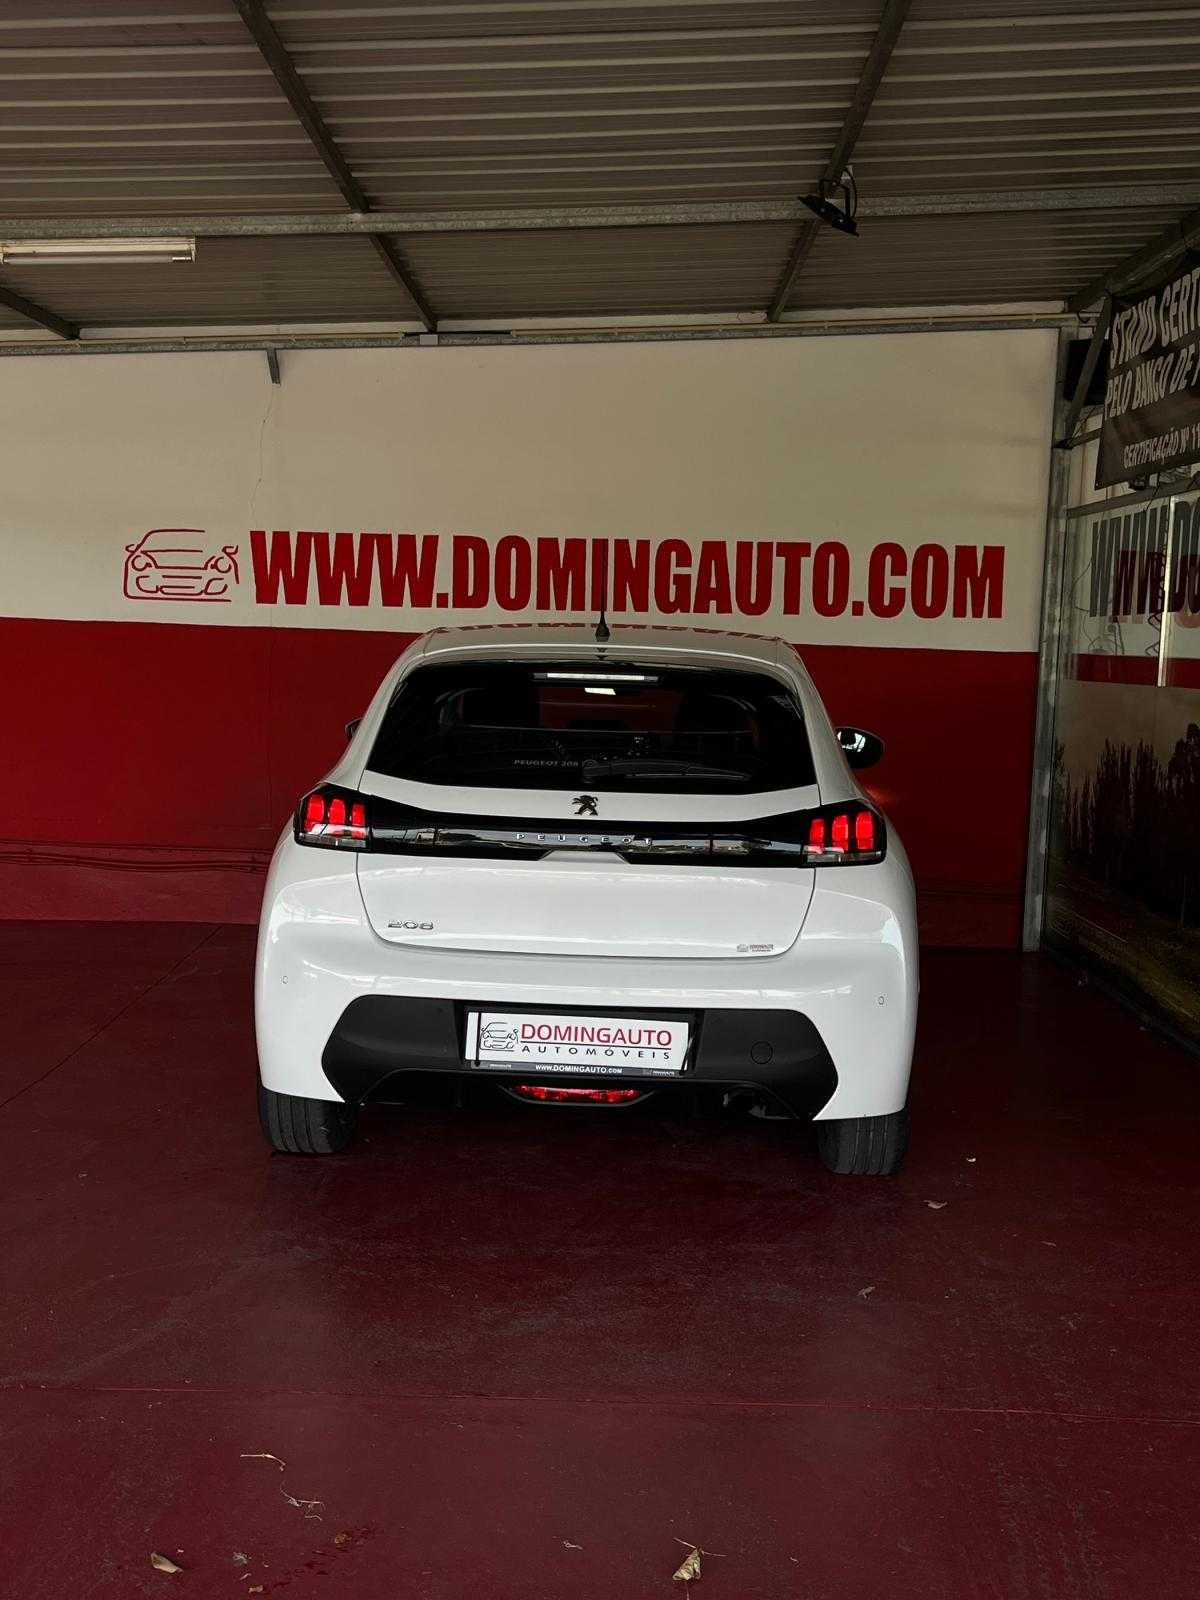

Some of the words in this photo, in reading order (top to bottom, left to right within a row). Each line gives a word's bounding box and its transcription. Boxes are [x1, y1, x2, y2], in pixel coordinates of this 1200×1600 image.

[1110, 295, 1156, 370] STAND
[1104, 369, 1133, 420] PELO
[1131, 353, 1175, 410] BANCO
[1169, 342, 1196, 394] DE
[249, 530, 1005, 619] WWW.DOMINGAUTO.COM
[516, 832, 653, 846] PEUGEOT
[388, 921, 433, 930] 208
[521, 1023, 672, 1047] DOMINGAUTO
[521, 1045, 670, 1060] AUTOMÓVEIS
